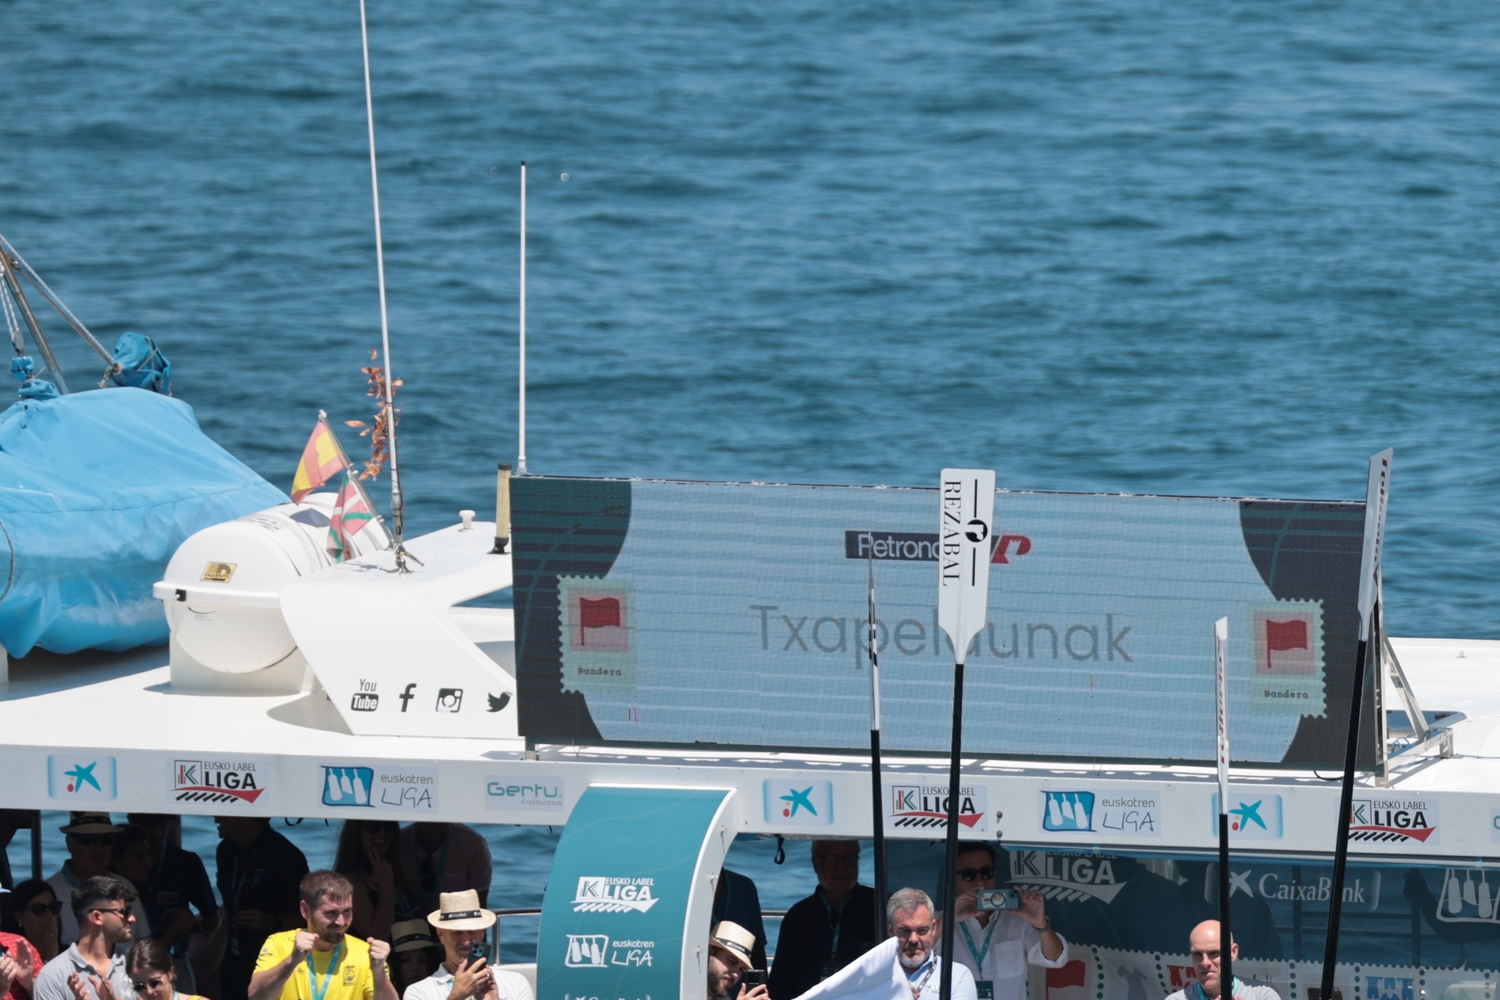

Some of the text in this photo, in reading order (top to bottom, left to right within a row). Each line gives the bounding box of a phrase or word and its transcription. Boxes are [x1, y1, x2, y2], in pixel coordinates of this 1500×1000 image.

[943, 480, 962, 587] REZABAL
[577, 666, 622, 678] Bandera
[359, 679, 377, 692] You
[1264, 689, 1309, 700] Bandera
[353, 694, 378, 712] Tube
[204, 761, 257, 772] EUSKO LABEL
[205, 772, 257, 790] LIGA
[380, 772, 434, 786] euskotren
[380, 788, 433, 809] LIGA
[1102, 797, 1156, 809] euskotren
[1373, 800, 1428, 812] EUSKO LABEL
[1103, 811, 1155, 832] LIGA
[1373, 811, 1427, 829] LIGA
[1046, 857, 1115, 885] LIGA
[605, 877, 655, 887] EUSKO LABEL
[1258, 872, 1365, 904] CaixaBnk
[603, 885, 652, 901] LIGA
[612, 939, 655, 949] euskotren
[611, 950, 653, 967] LIGA
